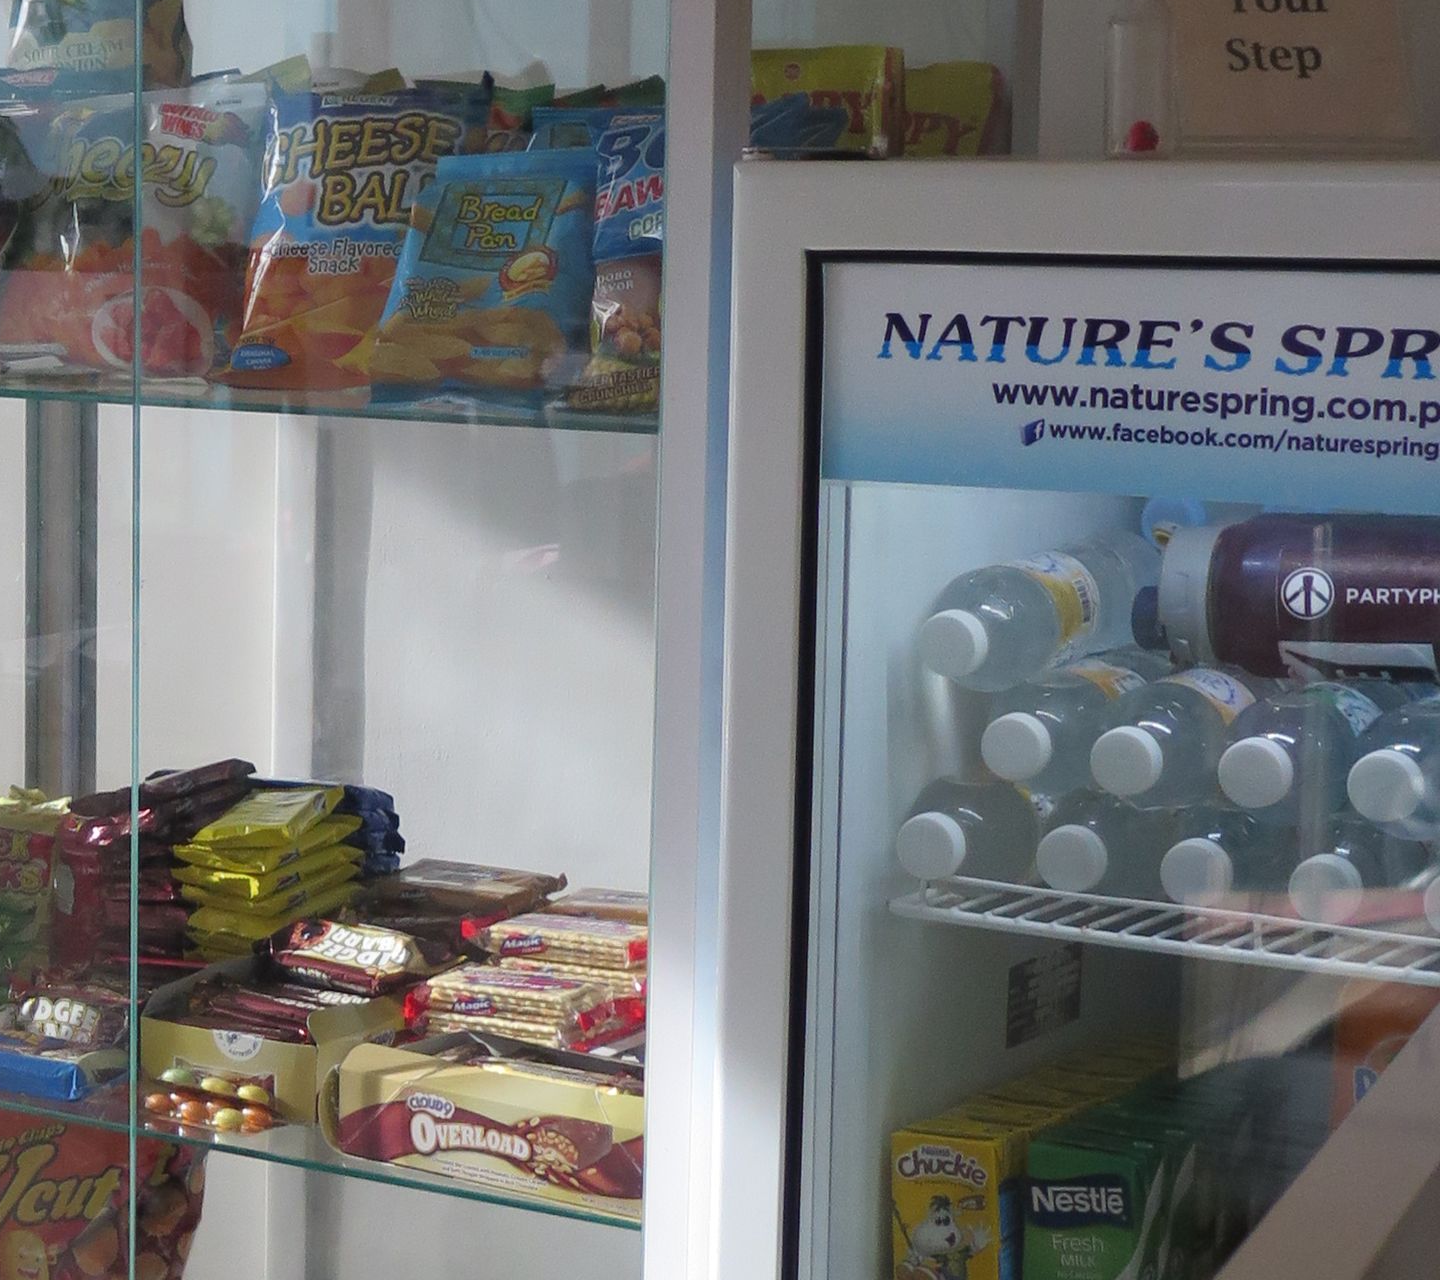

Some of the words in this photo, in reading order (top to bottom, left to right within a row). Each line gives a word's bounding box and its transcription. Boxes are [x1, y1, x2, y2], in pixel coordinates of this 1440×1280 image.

[1225, 37, 1323, 79] Step
[262, 113, 460, 191] CHEESE
[460, 195, 543, 223] Bread
[464, 223, 516, 249] Pan
[310, 257, 359, 273] Snack
[877, 313, 1255, 373] NATURE'S
[992, 382, 1440, 428] www.naturespring.com.p
[1049, 421, 1439, 462] www.facebook.com/naturespring
[503, 936, 542, 949] Magic
[453, 999, 491, 1013] Magic
[897, 1155, 987, 1186] Chuckie
[1051, 1233, 1105, 1254] Fresh
[1060, 1255, 1097, 1268] MILK
